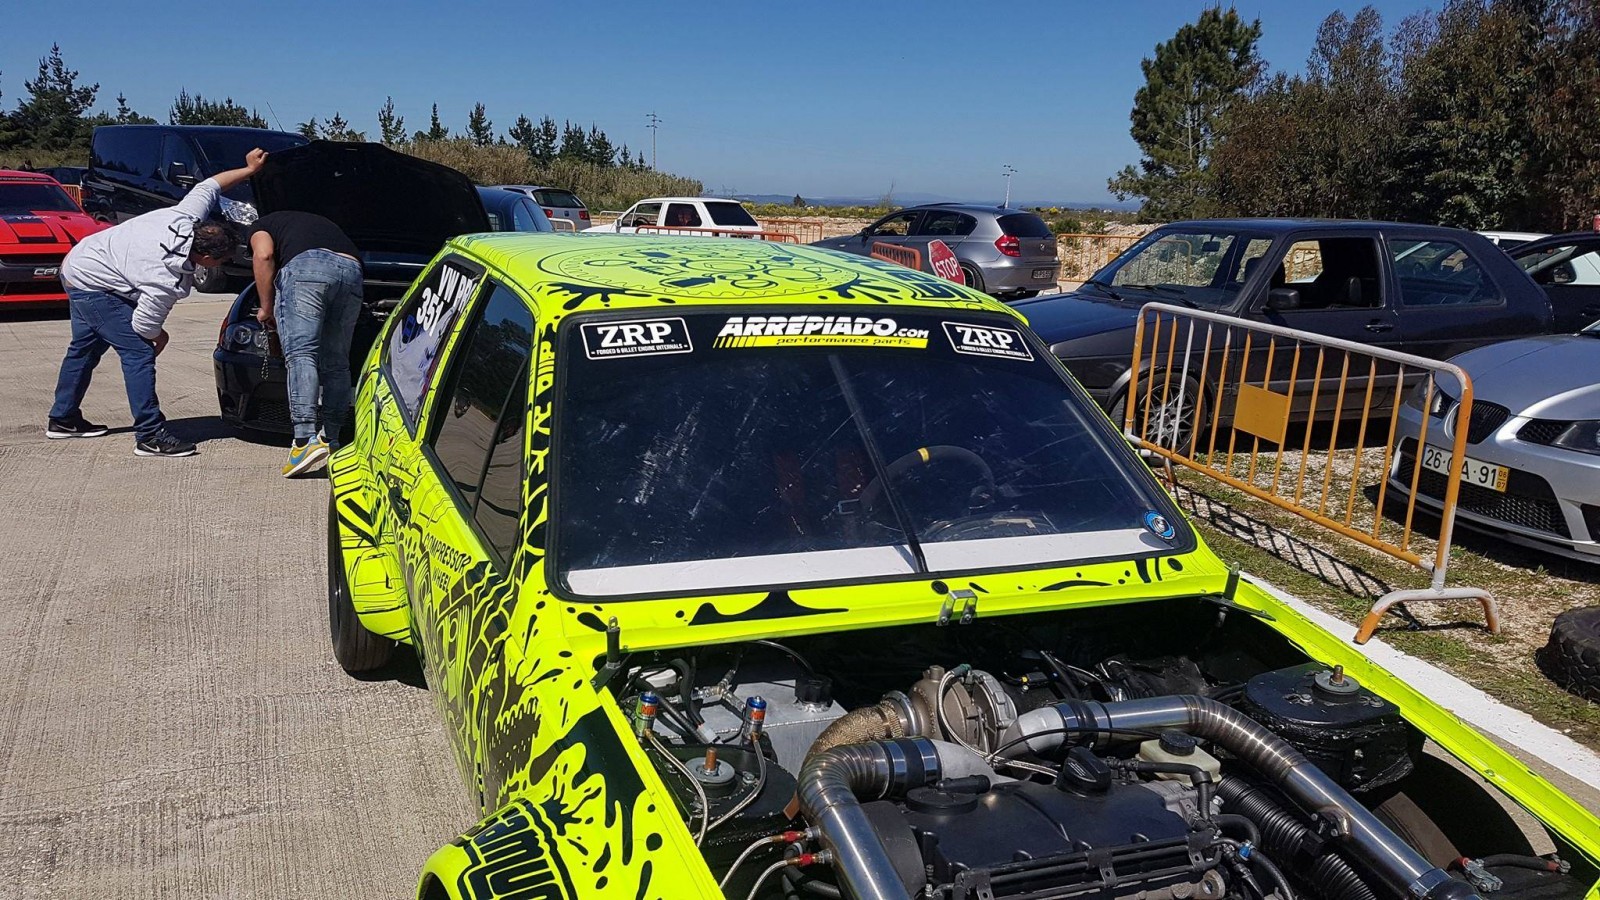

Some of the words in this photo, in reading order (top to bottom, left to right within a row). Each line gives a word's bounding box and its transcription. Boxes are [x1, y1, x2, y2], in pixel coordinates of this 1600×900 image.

[935, 257, 959, 279] STOP
[437, 264, 460, 303] VW
[416, 287, 444, 337] 351
[596, 322, 672, 347] ZRP
[776, 337, 868, 345] performance
[871, 337, 911, 346] parts
[955, 326, 1013, 349] ZRP
[424, 532, 472, 575] COMPRESSOR
[432, 567, 451, 594] WHEEL
